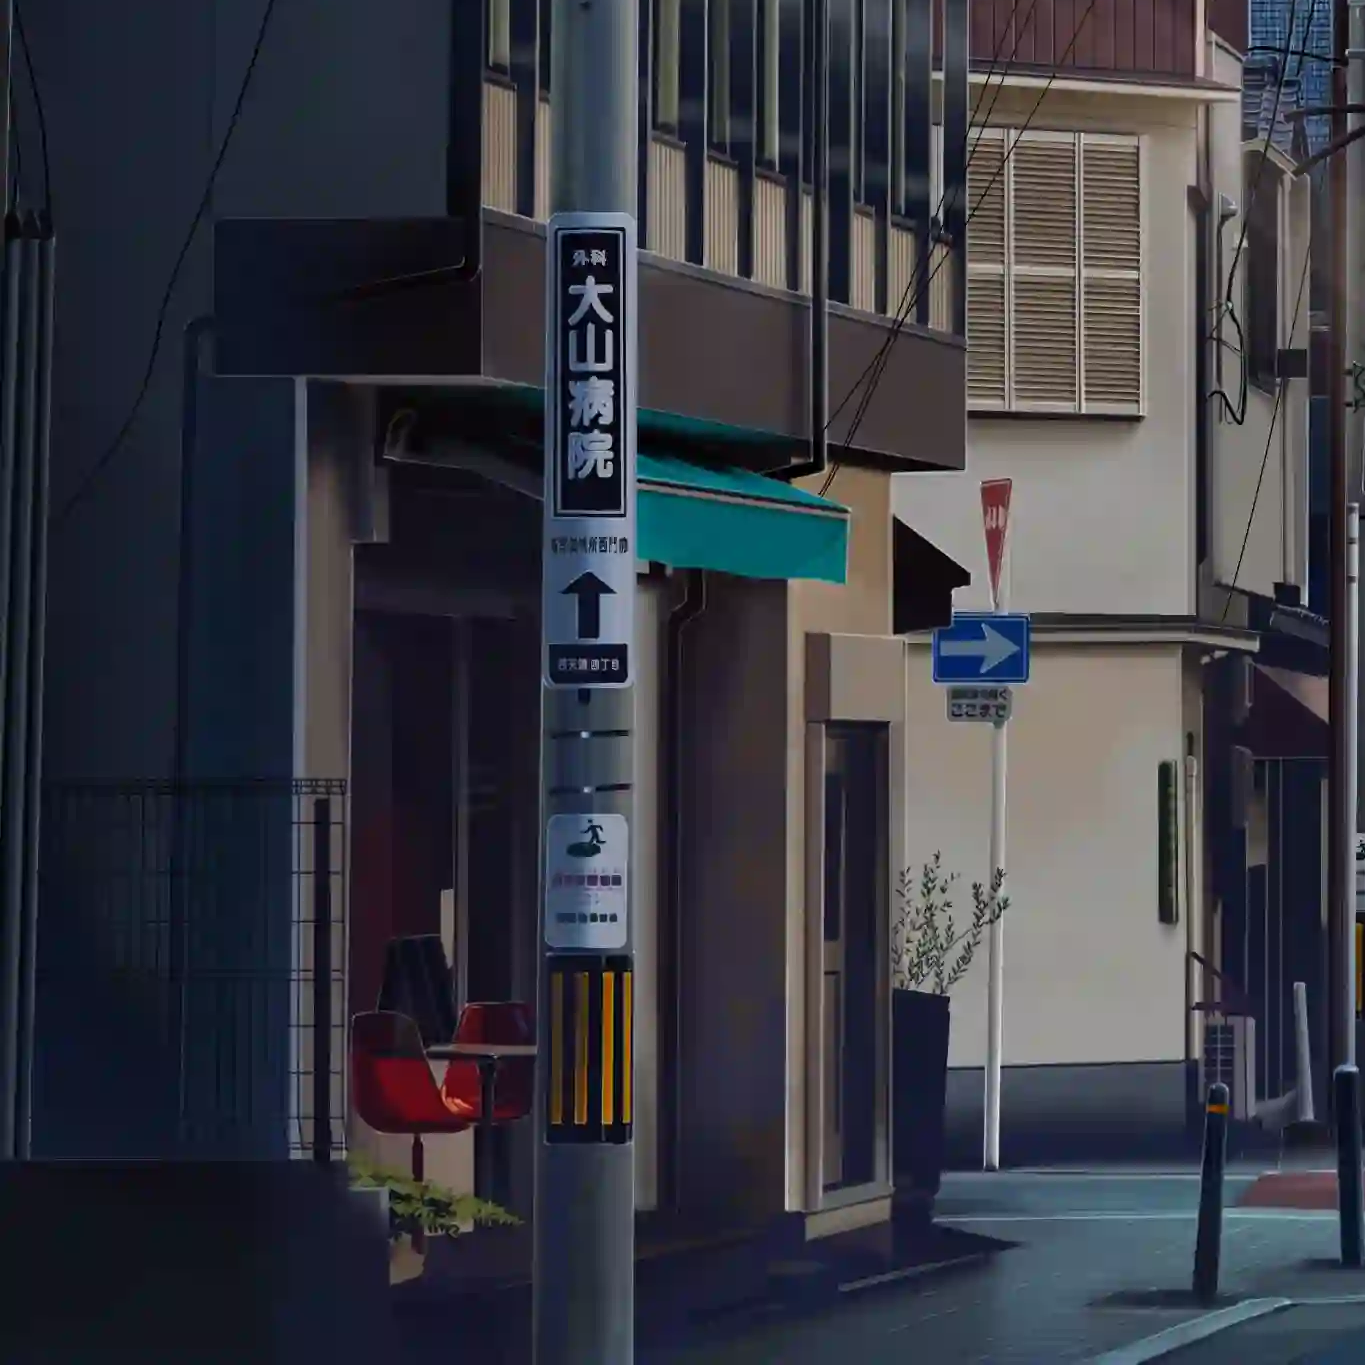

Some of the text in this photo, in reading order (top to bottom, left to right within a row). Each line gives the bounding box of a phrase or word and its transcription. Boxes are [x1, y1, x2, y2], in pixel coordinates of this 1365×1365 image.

[572, 249, 607, 266] 外科
[567, 275, 614, 480] 大山病院
[951, 703, 1007, 718] ここまで
